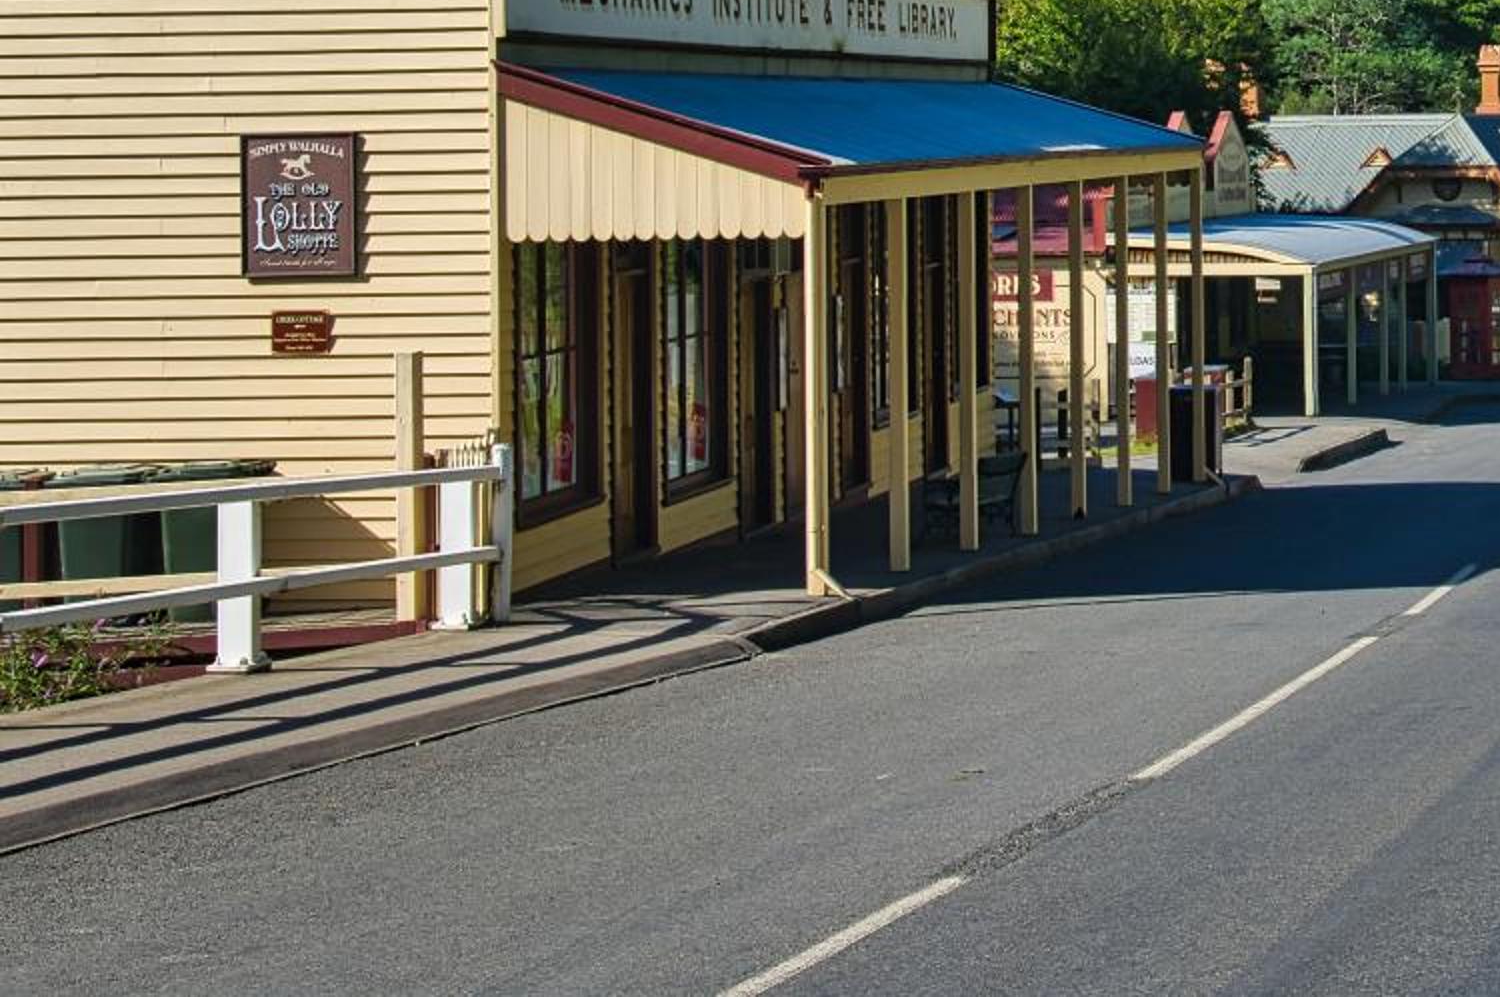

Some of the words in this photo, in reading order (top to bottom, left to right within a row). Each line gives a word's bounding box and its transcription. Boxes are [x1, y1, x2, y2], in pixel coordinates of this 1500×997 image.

[289, 142, 344, 158] WALHALLA
[270, 183, 295, 200] THE
[301, 183, 330, 197] OLD
[253, 196, 341, 251] LOLLY
